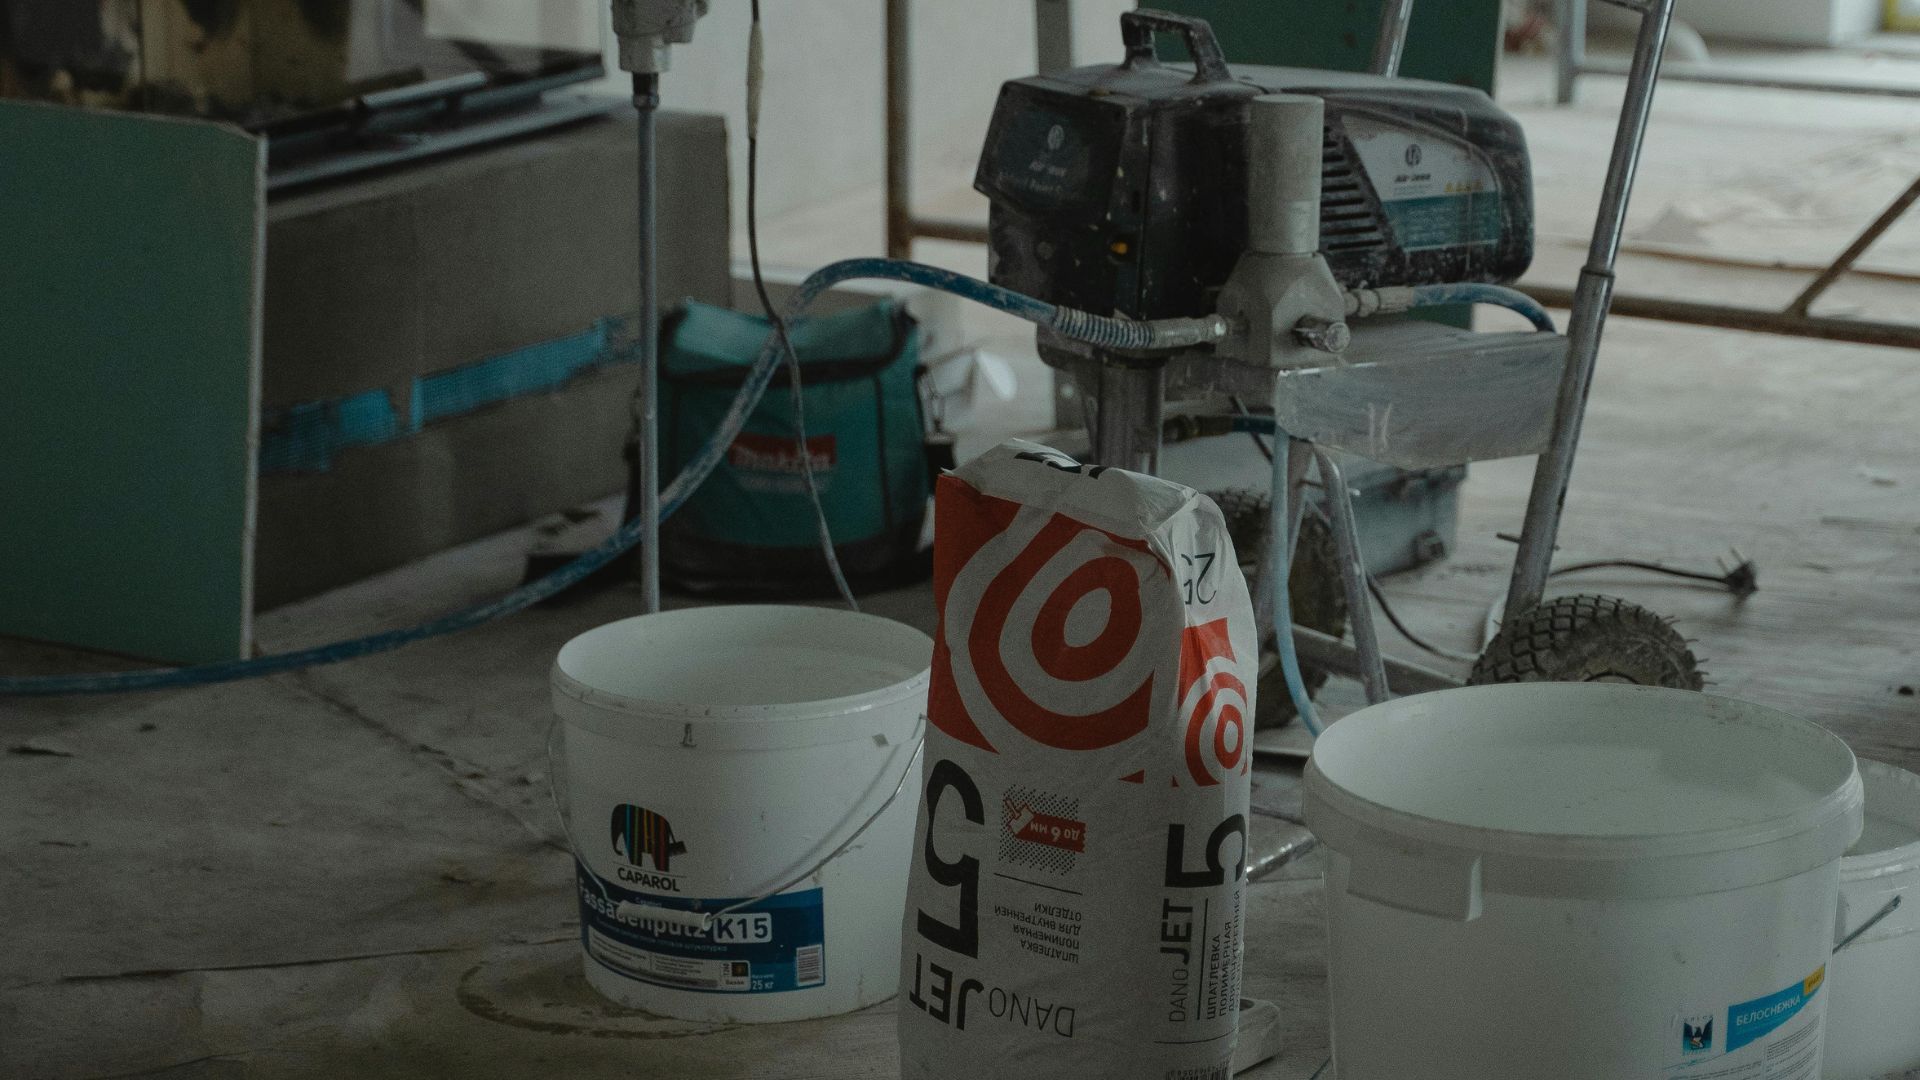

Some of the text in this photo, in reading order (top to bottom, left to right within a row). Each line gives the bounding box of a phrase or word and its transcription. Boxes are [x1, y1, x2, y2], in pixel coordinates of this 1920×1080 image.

[1051, 825, 1062, 843] 6
[917, 759, 985, 960] 5
[1164, 814, 1246, 888] 5
[617, 867, 681, 892] CAPAROL
[994, 904, 1081, 936] ДЛЯ ВНУТРЕННЕЙ
[1034, 902, 1082, 921] ОТДЕЛКИ
[716, 917, 769, 941] K15
[1013, 923, 1080, 950] ПОЛИМЕРНАЯ
[1019, 939, 1079, 963] ШПАТЛЕВКА
[1207, 934, 1221, 1020] ШПАТЛЕВКА
[1218, 921, 1232, 1017] ПОЛИМЕРНАЯ
[752, 979, 763, 990] 25
[1735, 994, 1801, 1026] БЕЛОСНЕЖКА
